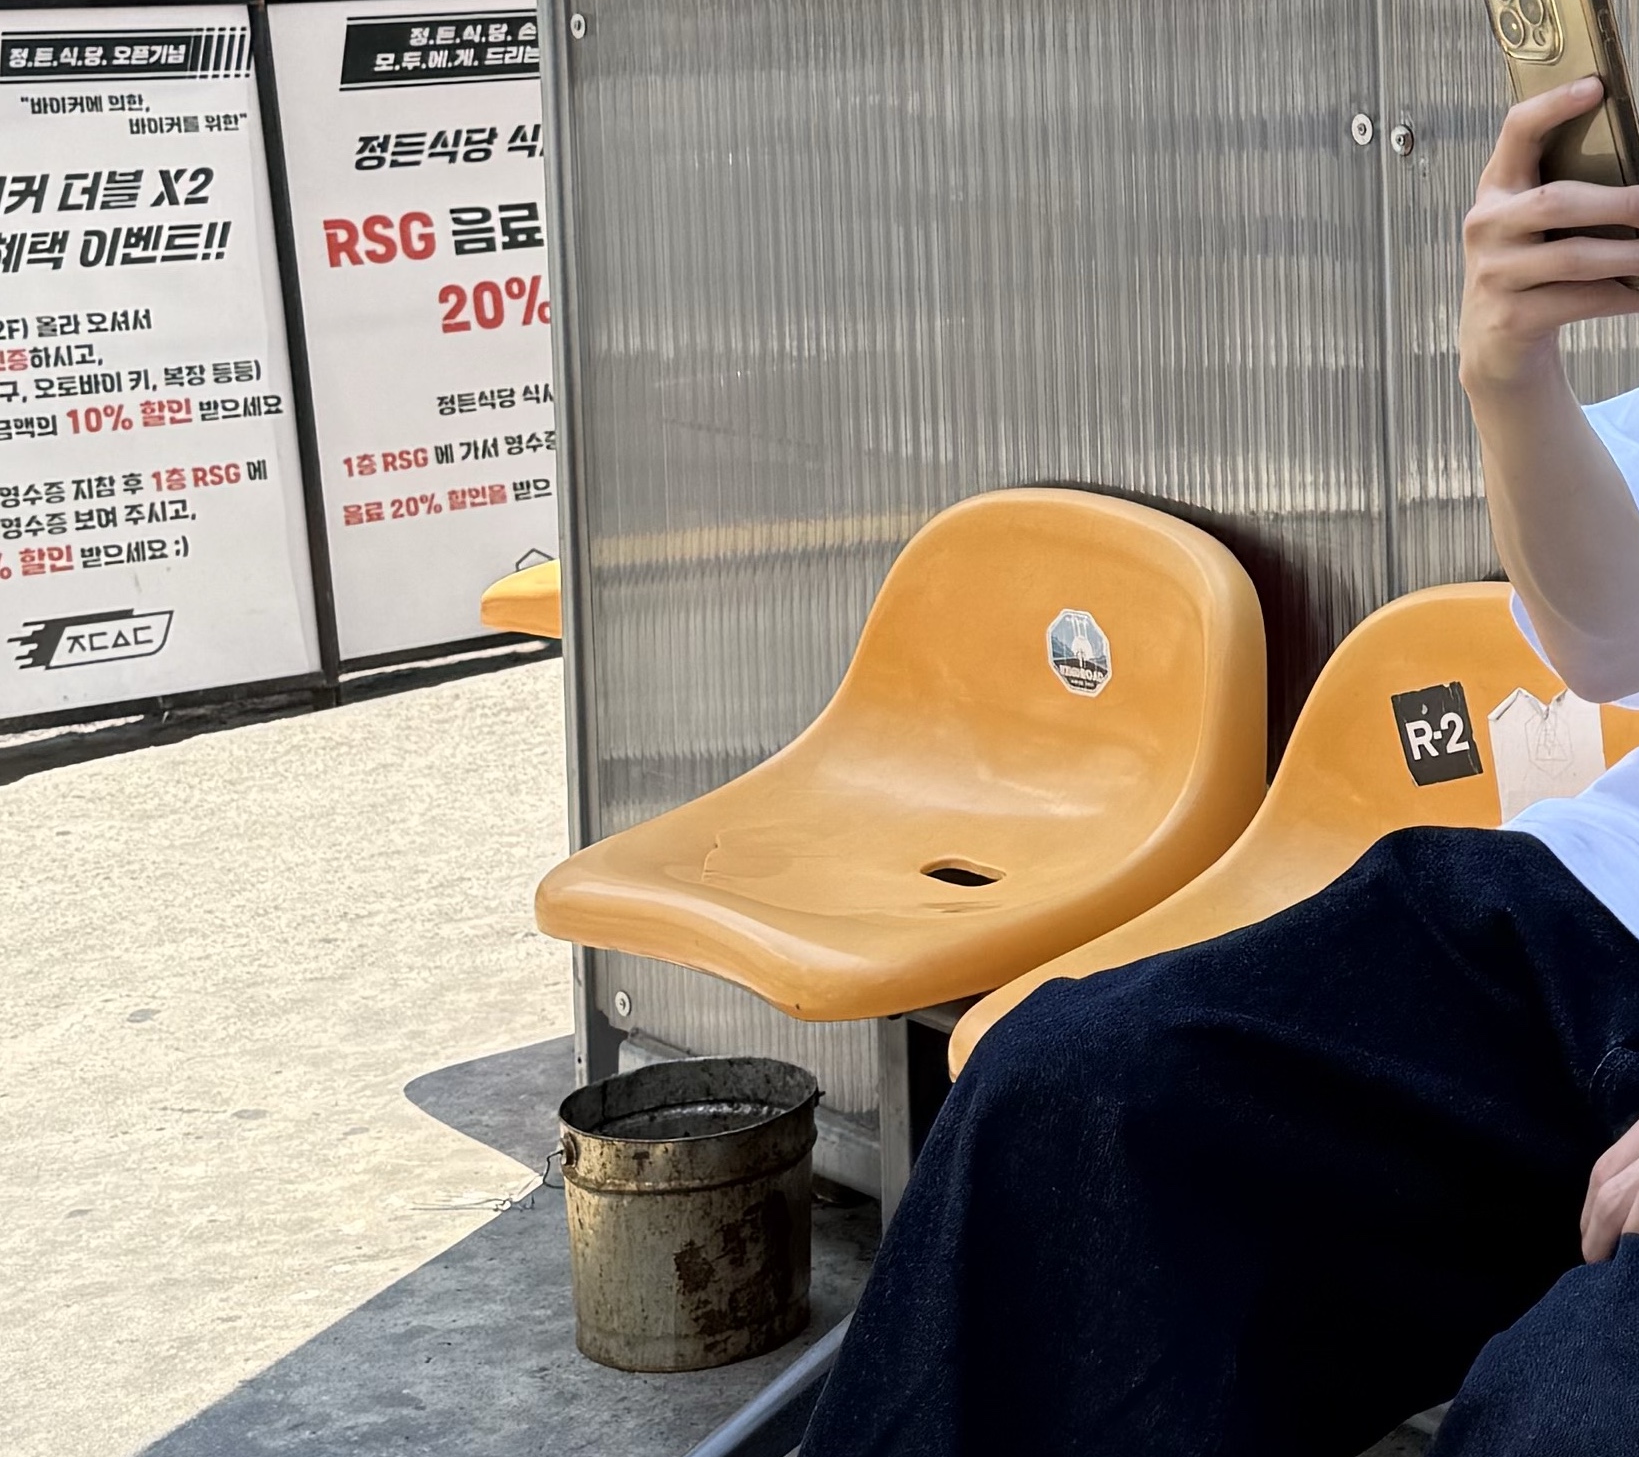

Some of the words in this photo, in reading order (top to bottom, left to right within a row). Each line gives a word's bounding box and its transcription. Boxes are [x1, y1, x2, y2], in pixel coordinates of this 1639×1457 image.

[111, 43, 187, 66] 오픈기념
[20, 95, 104, 115] "바이커에
[108, 94, 150, 113] 의한,
[129, 116, 200, 135] 바이커를
[205, 113, 247, 132] 위한"
[354, 127, 498, 171] 정든식당
[507, 123, 545, 158] 식
[57, 169, 144, 212] 더블
[150, 166, 215, 208] X2
[79, 221, 232, 268] 이벤트!!
[322, 211, 436, 268] RSG
[449, 201, 545, 256] 음료
[36, 314, 81, 338] 올라
[86, 309, 153, 333] 오셔서
[438, 275, 551, 333] 20%
[34, 372, 123, 399] 오토바이
[128, 369, 157, 392] 키,
[164, 364, 206, 387] 복장
[212, 360, 261, 384] 등등)
[66, 404, 134, 435] 10%
[139, 398, 193, 428] 할인
[198, 395, 285, 422] 받으세요
[436, 387, 516, 416] 정든식당
[343, 453, 377, 478] 1층
[381, 447, 429, 473] RSG
[434, 443, 455, 465] 에
[459, 437, 500, 462] 가서
[0, 481, 66, 508] 영수증
[71, 476, 116, 500] 지참
[121, 473, 144, 495] 후
[151, 467, 187, 492] 1층
[192, 463, 242, 488] RSG
[246, 459, 268, 481] 에
[0, 512, 68, 540] 영수증
[74, 506, 117, 531] 보여
[124, 499, 197, 525] 주시고,
[343, 501, 385, 526] 음료
[390, 493, 443, 519] 20%
[447, 483, 508, 511] 할인을
[18, 545, 75, 577] 할인
[80, 538, 169, 569] 받으세요
[1405, 712, 1469, 760] R-2
